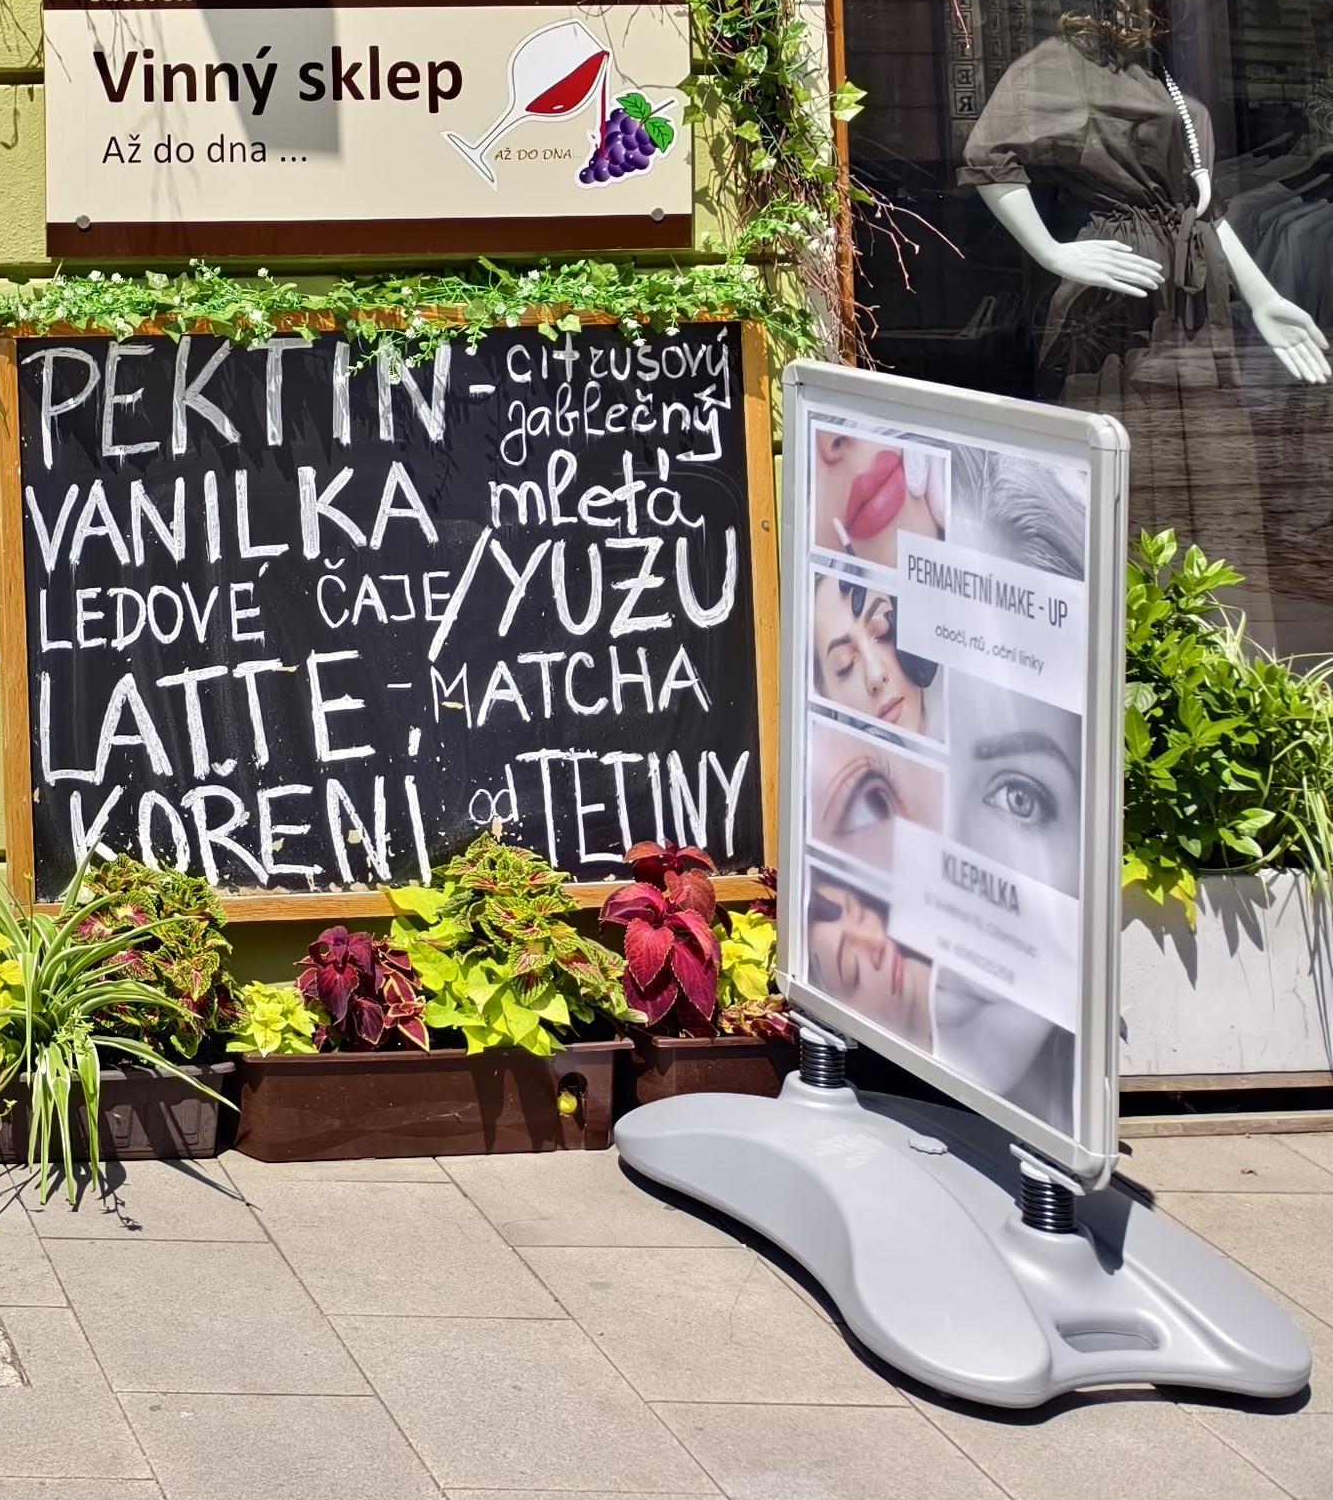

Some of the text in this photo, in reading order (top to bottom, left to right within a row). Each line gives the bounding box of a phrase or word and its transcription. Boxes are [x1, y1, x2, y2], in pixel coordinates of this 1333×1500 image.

[92, 44, 465, 116] Vinný sklep
[102, 132, 144, 166] Až
[154, 133, 196, 166] do
[206, 133, 270, 165] dna
[494, 147, 513, 161] AŽ
[517, 148, 539, 161] DO
[21, 335, 454, 471] PEKTIN
[23, 448, 707, 574] VANILKA mletá
[316, 556, 452, 629] ČAJE
[908, 553, 1069, 629] PERMANETNÍ MAKE UP
[39, 644, 713, 785] LATTE MATCHA
[468, 762, 521, 825] od
[515, 749, 751, 871] TETINY
